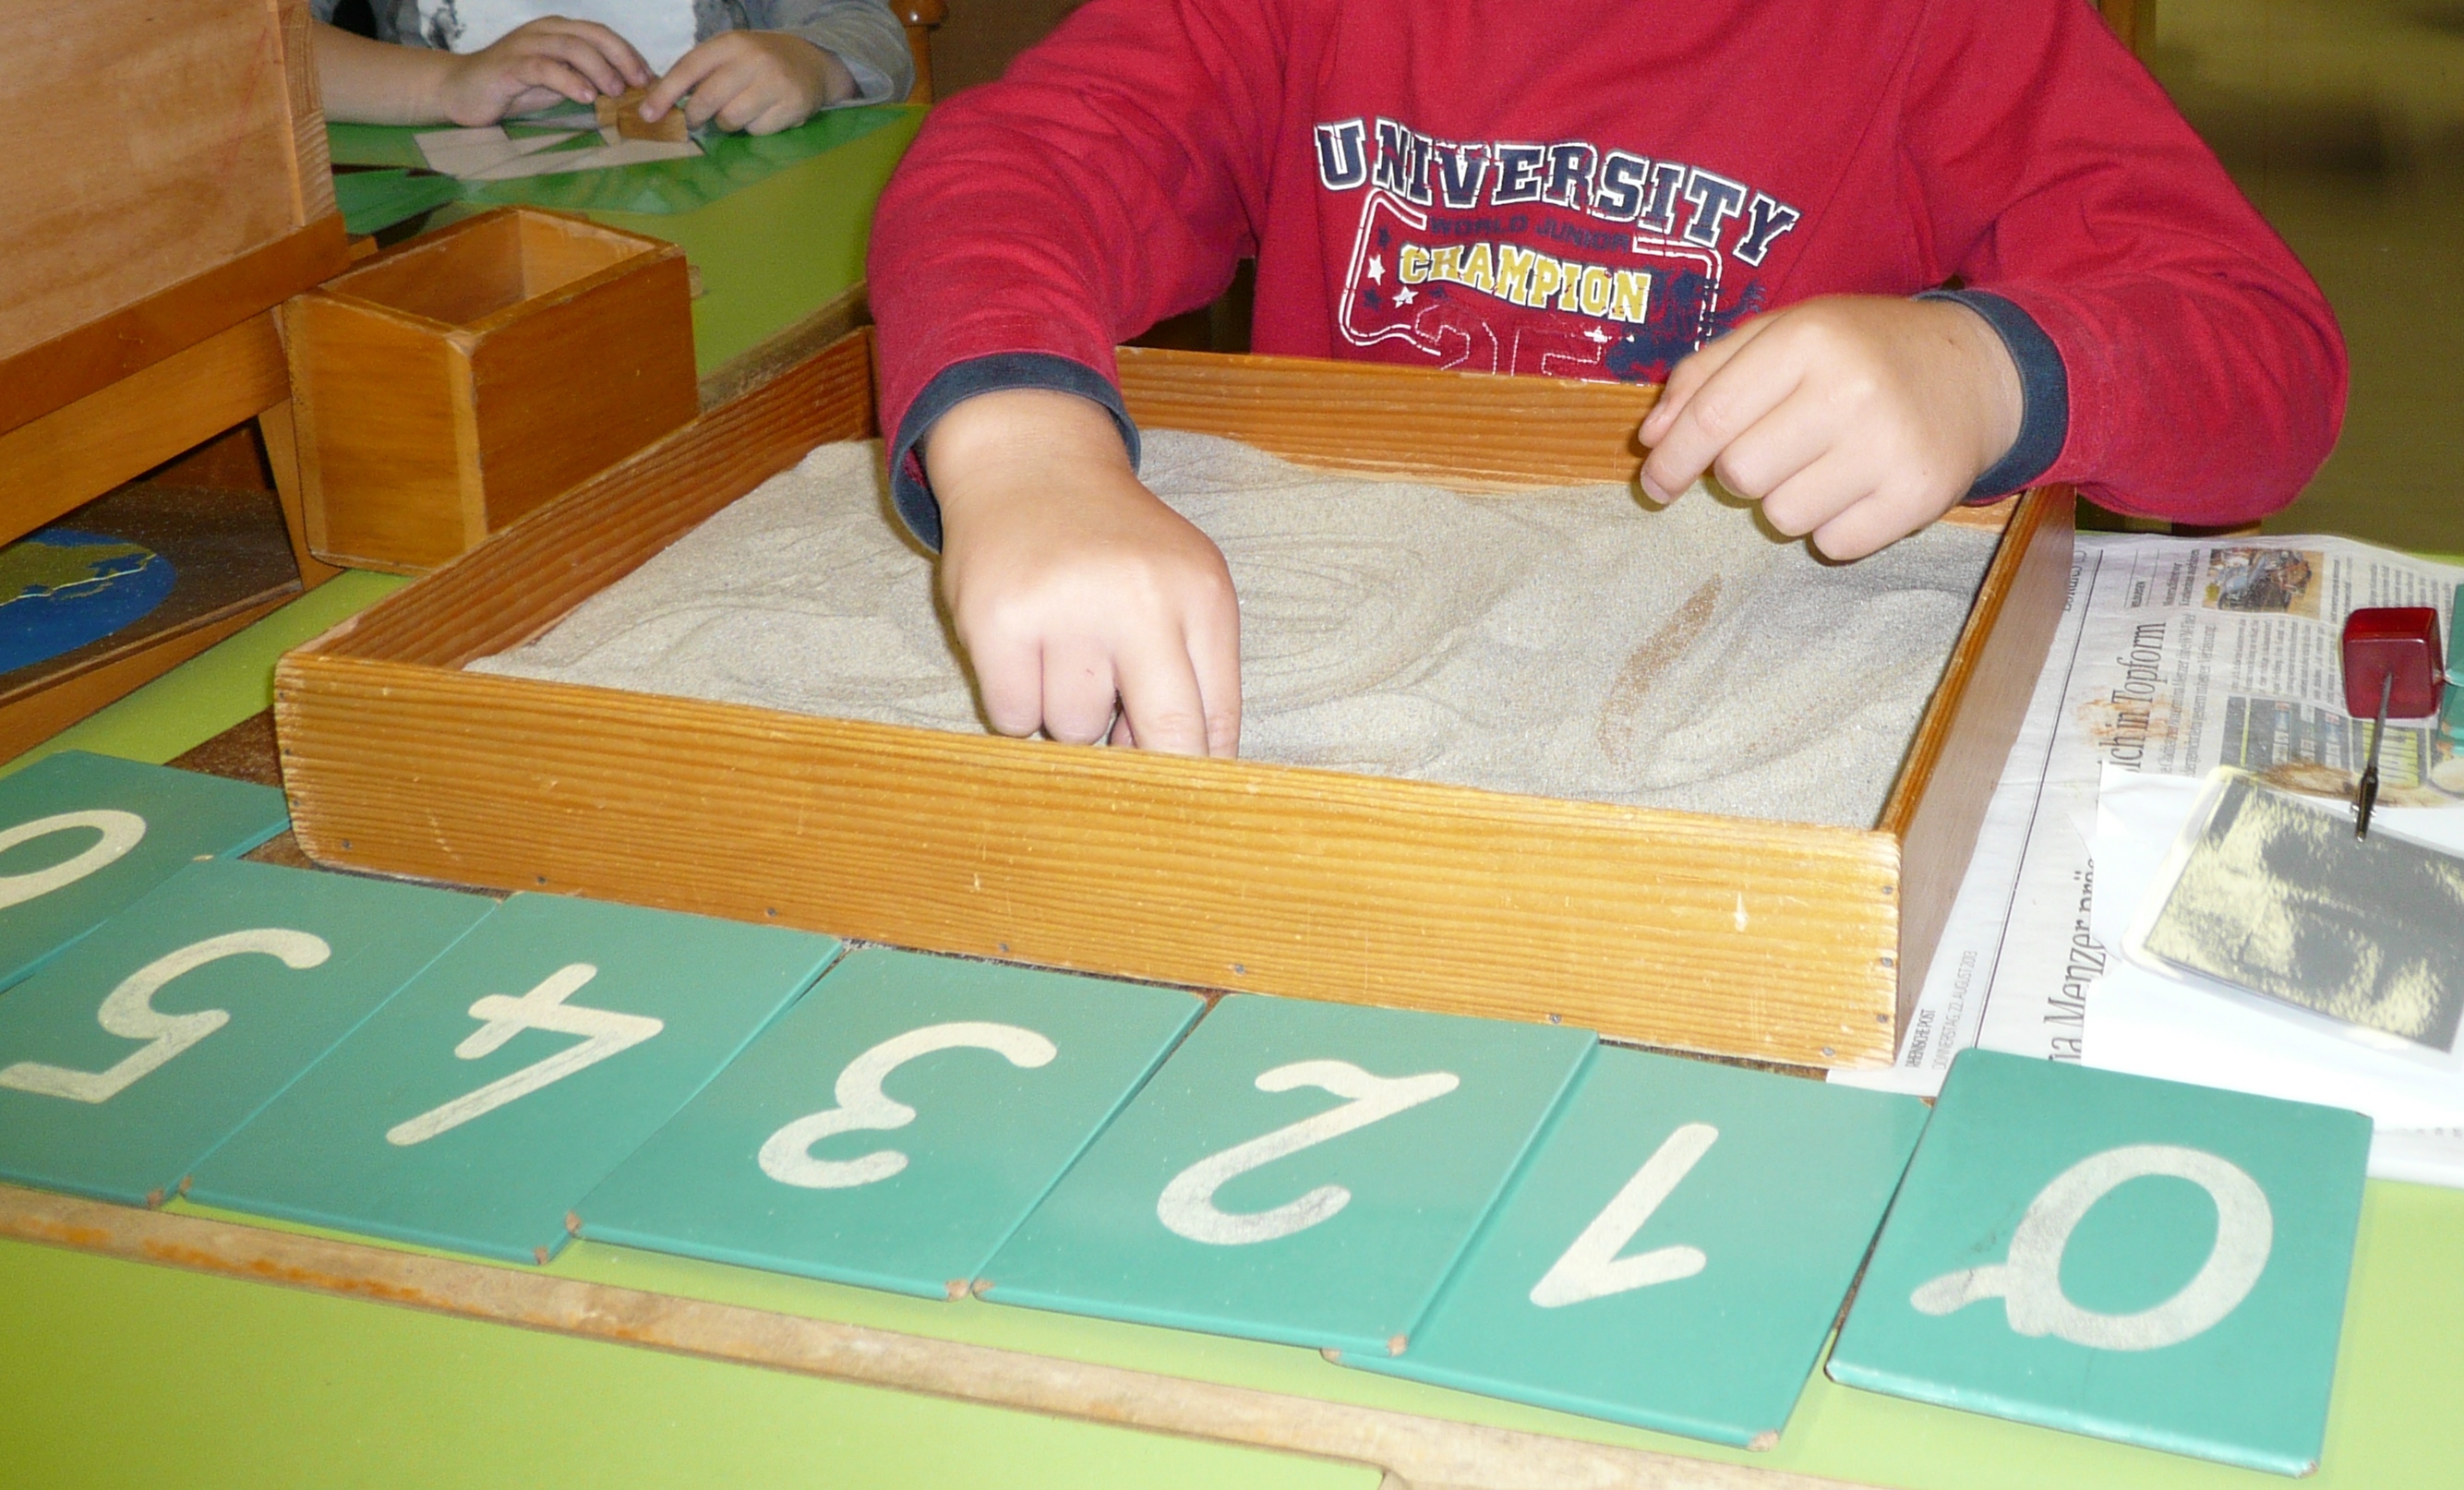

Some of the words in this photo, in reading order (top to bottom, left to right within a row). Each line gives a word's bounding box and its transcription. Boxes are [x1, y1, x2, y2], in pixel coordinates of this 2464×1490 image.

[1315, 117, 1799, 266] UNIVERSITY
[1429, 213, 1529, 236] WORLD
[1536, 216, 1630, 253] JUNIOR
[1399, 242, 1653, 323] CHAMPION
[2110, 620, 2167, 705] Topform
[2097, 733, 2145, 774] ich
[2106, 710, 2151, 730] in
[0, 928, 331, 1103] 5
[1917, 1009, 1936, 1027] POST
[1953, 968, 1973, 1001] AUGUST
[2043, 919, 2106, 1027] Menzer
[386, 963, 665, 1147] 4
[758, 1021, 1057, 1189] 3
[1157, 1059, 1460, 1245] 2
[1530, 1124, 1719, 1308] 1
